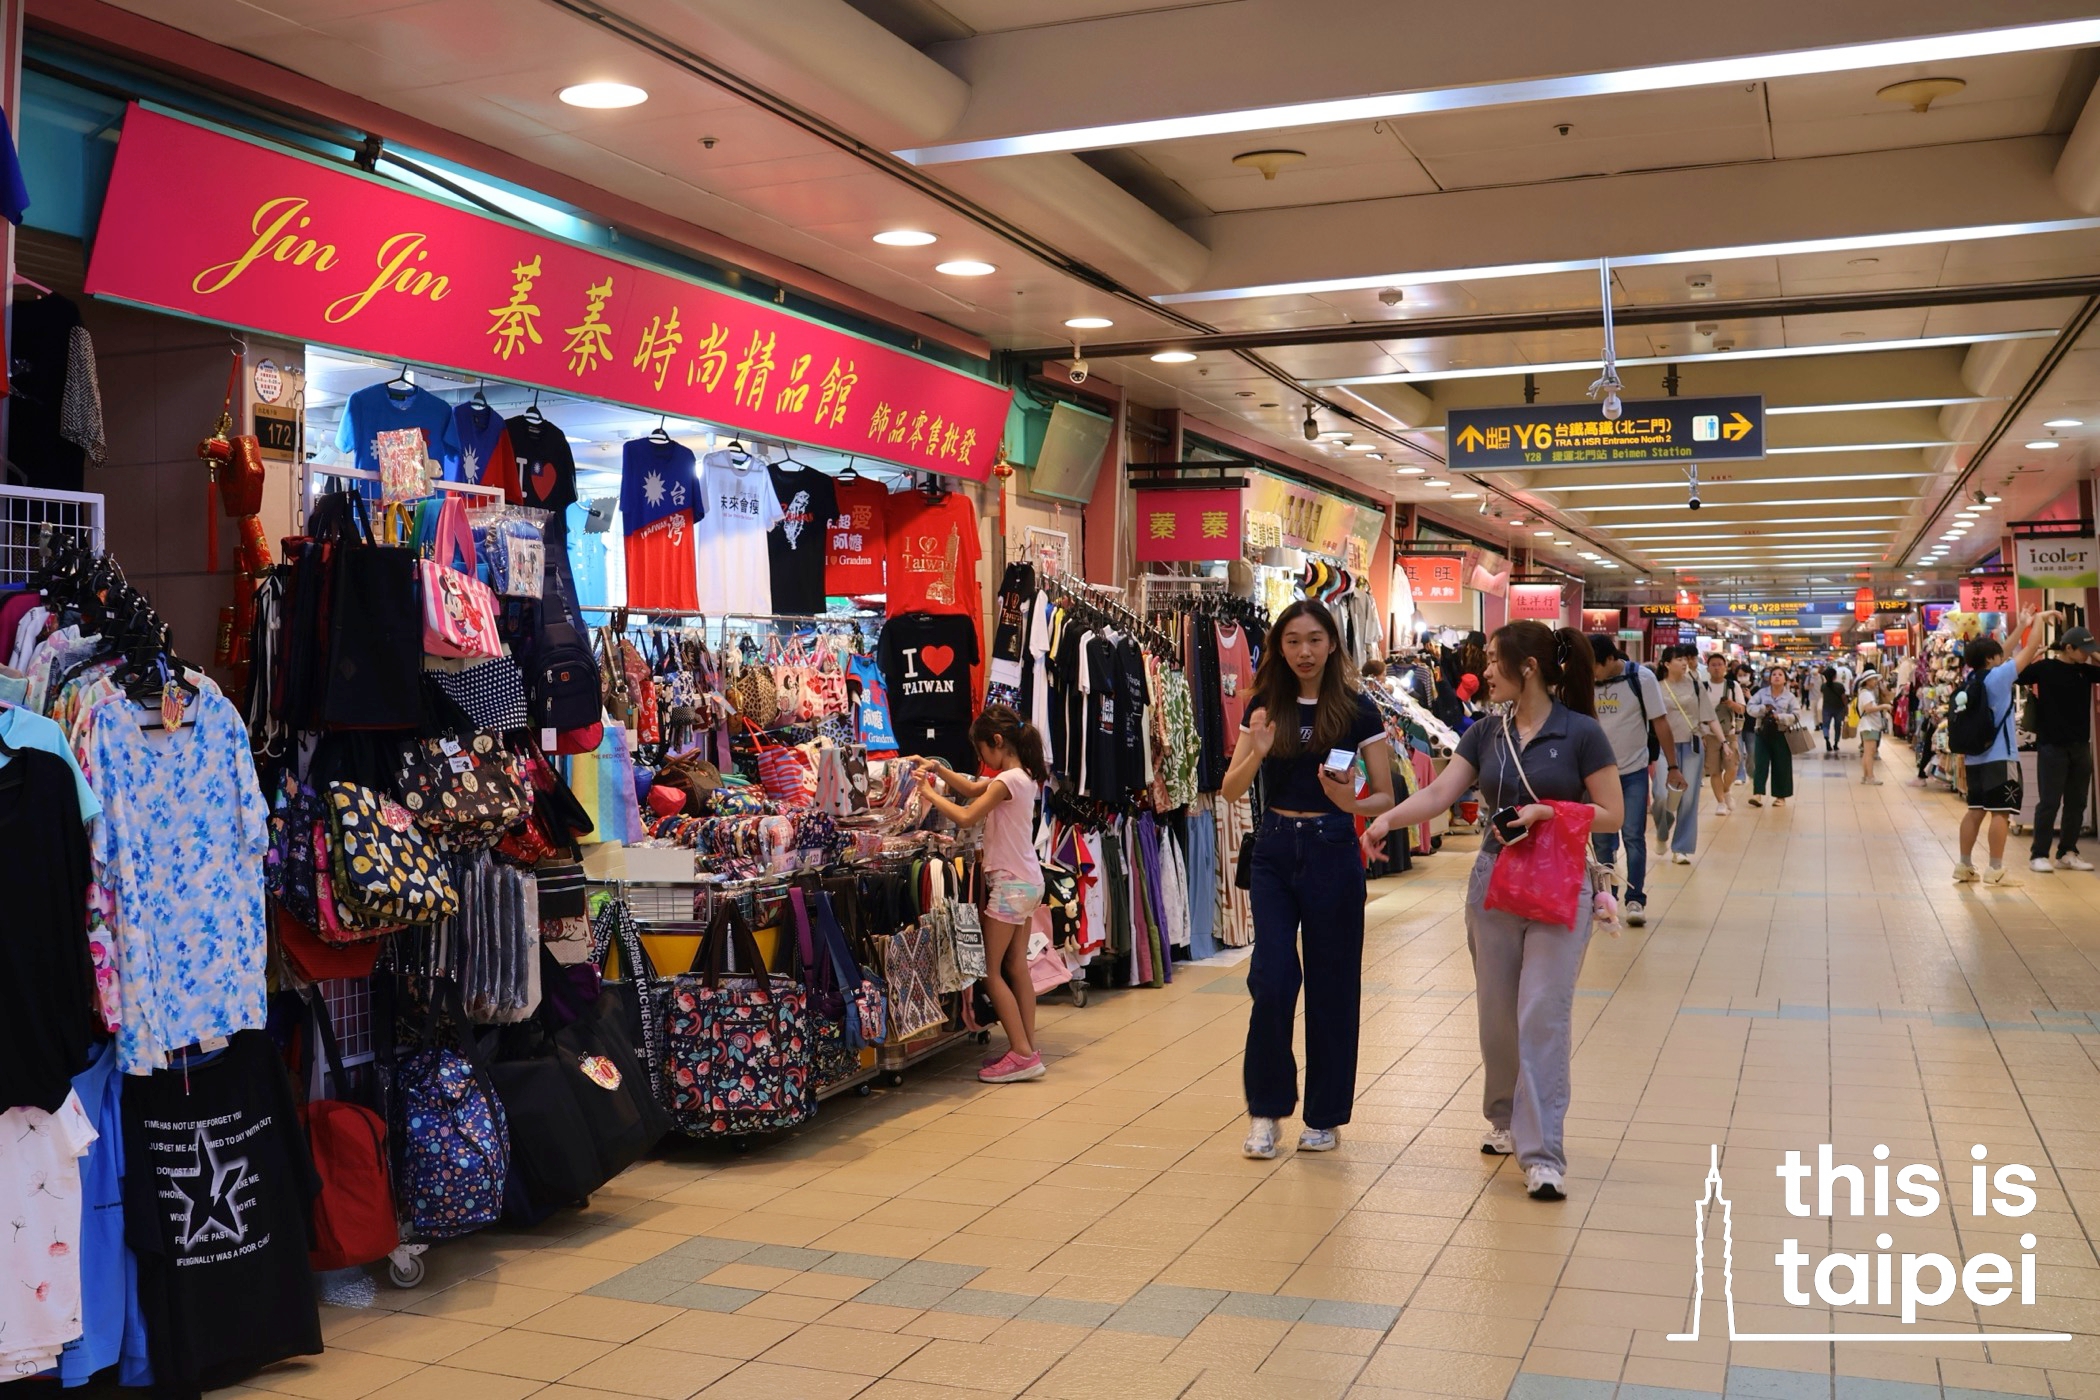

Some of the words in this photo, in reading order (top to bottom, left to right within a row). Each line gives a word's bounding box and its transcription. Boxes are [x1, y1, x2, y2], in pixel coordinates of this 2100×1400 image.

[192, 196, 340, 294] Jin
[324, 232, 451, 324] Jin
[268, 423, 292, 446] 172
[1485, 427, 1511, 450] 出口
[1512, 423, 1552, 450] Y6
[1554, 438, 1571, 447] TRA
[1573, 438, 1580, 446] &
[1582, 437, 1601, 446] HSR
[1602, 435, 1639, 445] Entrance
[1640, 434, 1664, 444] North
[1665, 434, 1672, 443] 2
[1524, 453, 1542, 463] Y28
[1612, 447, 1649, 459] Beimen
[1652, 445, 1693, 458] Station
[838, 555, 872, 565] Grandma
[1516, 594, 1556, 607] 佳洋行
[1659, 605, 1671, 614] Y6
[902, 648, 919, 678] I
[902, 680, 955, 696] TAIWAN
[172, 1121, 187, 1131] NOT
[207, 1114, 233, 1128] FORGET
[175, 1143, 187, 1153] ME
[225, 1136, 236, 1146] TO
[211, 1230, 229, 1243] PAST
[216, 1249, 233, 1262] WAS
[239, 1243, 257, 1256] POOR
